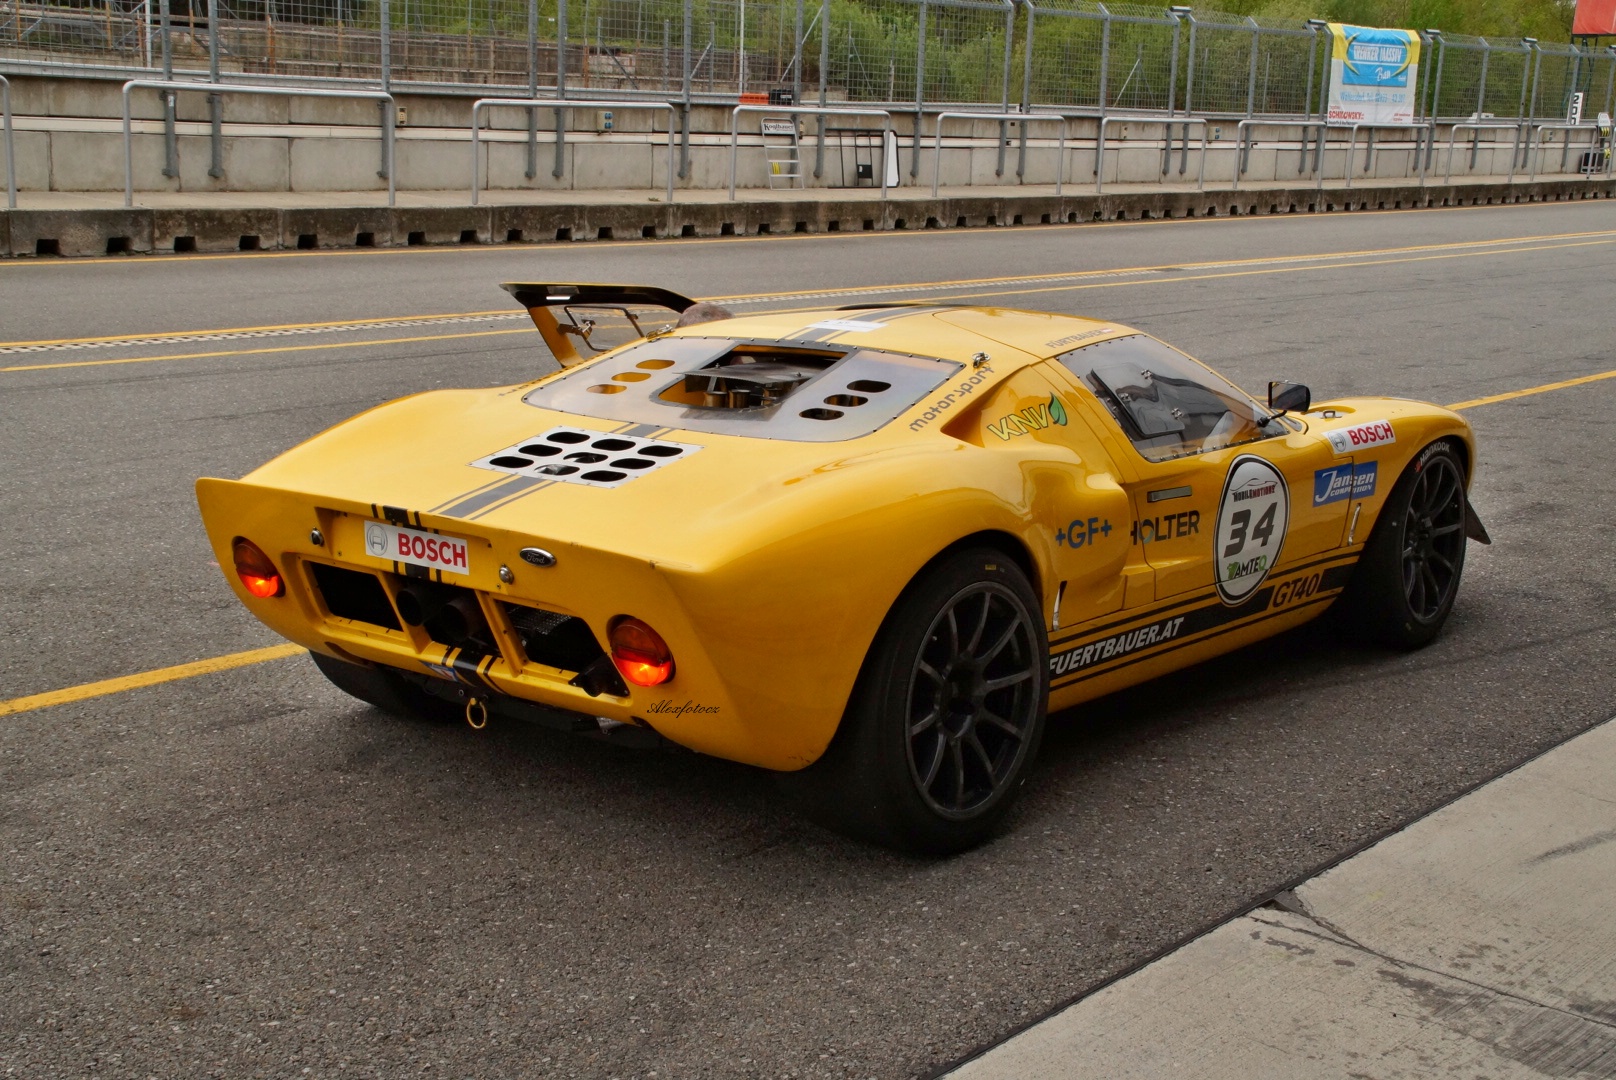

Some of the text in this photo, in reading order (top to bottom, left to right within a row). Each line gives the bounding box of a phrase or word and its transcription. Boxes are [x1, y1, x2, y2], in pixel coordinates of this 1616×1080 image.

[909, 364, 995, 432] motorsport
[987, 403, 1049, 441] KNV
[1347, 422, 1394, 446] BOSCH
[1314, 470, 1375, 502] Jansen
[1223, 501, 1278, 558] 34
[397, 532, 467, 569] BOSCH
[1272, 572, 1321, 608] GT40
[1049, 616, 1185, 675] FUERTBAUER.AT
